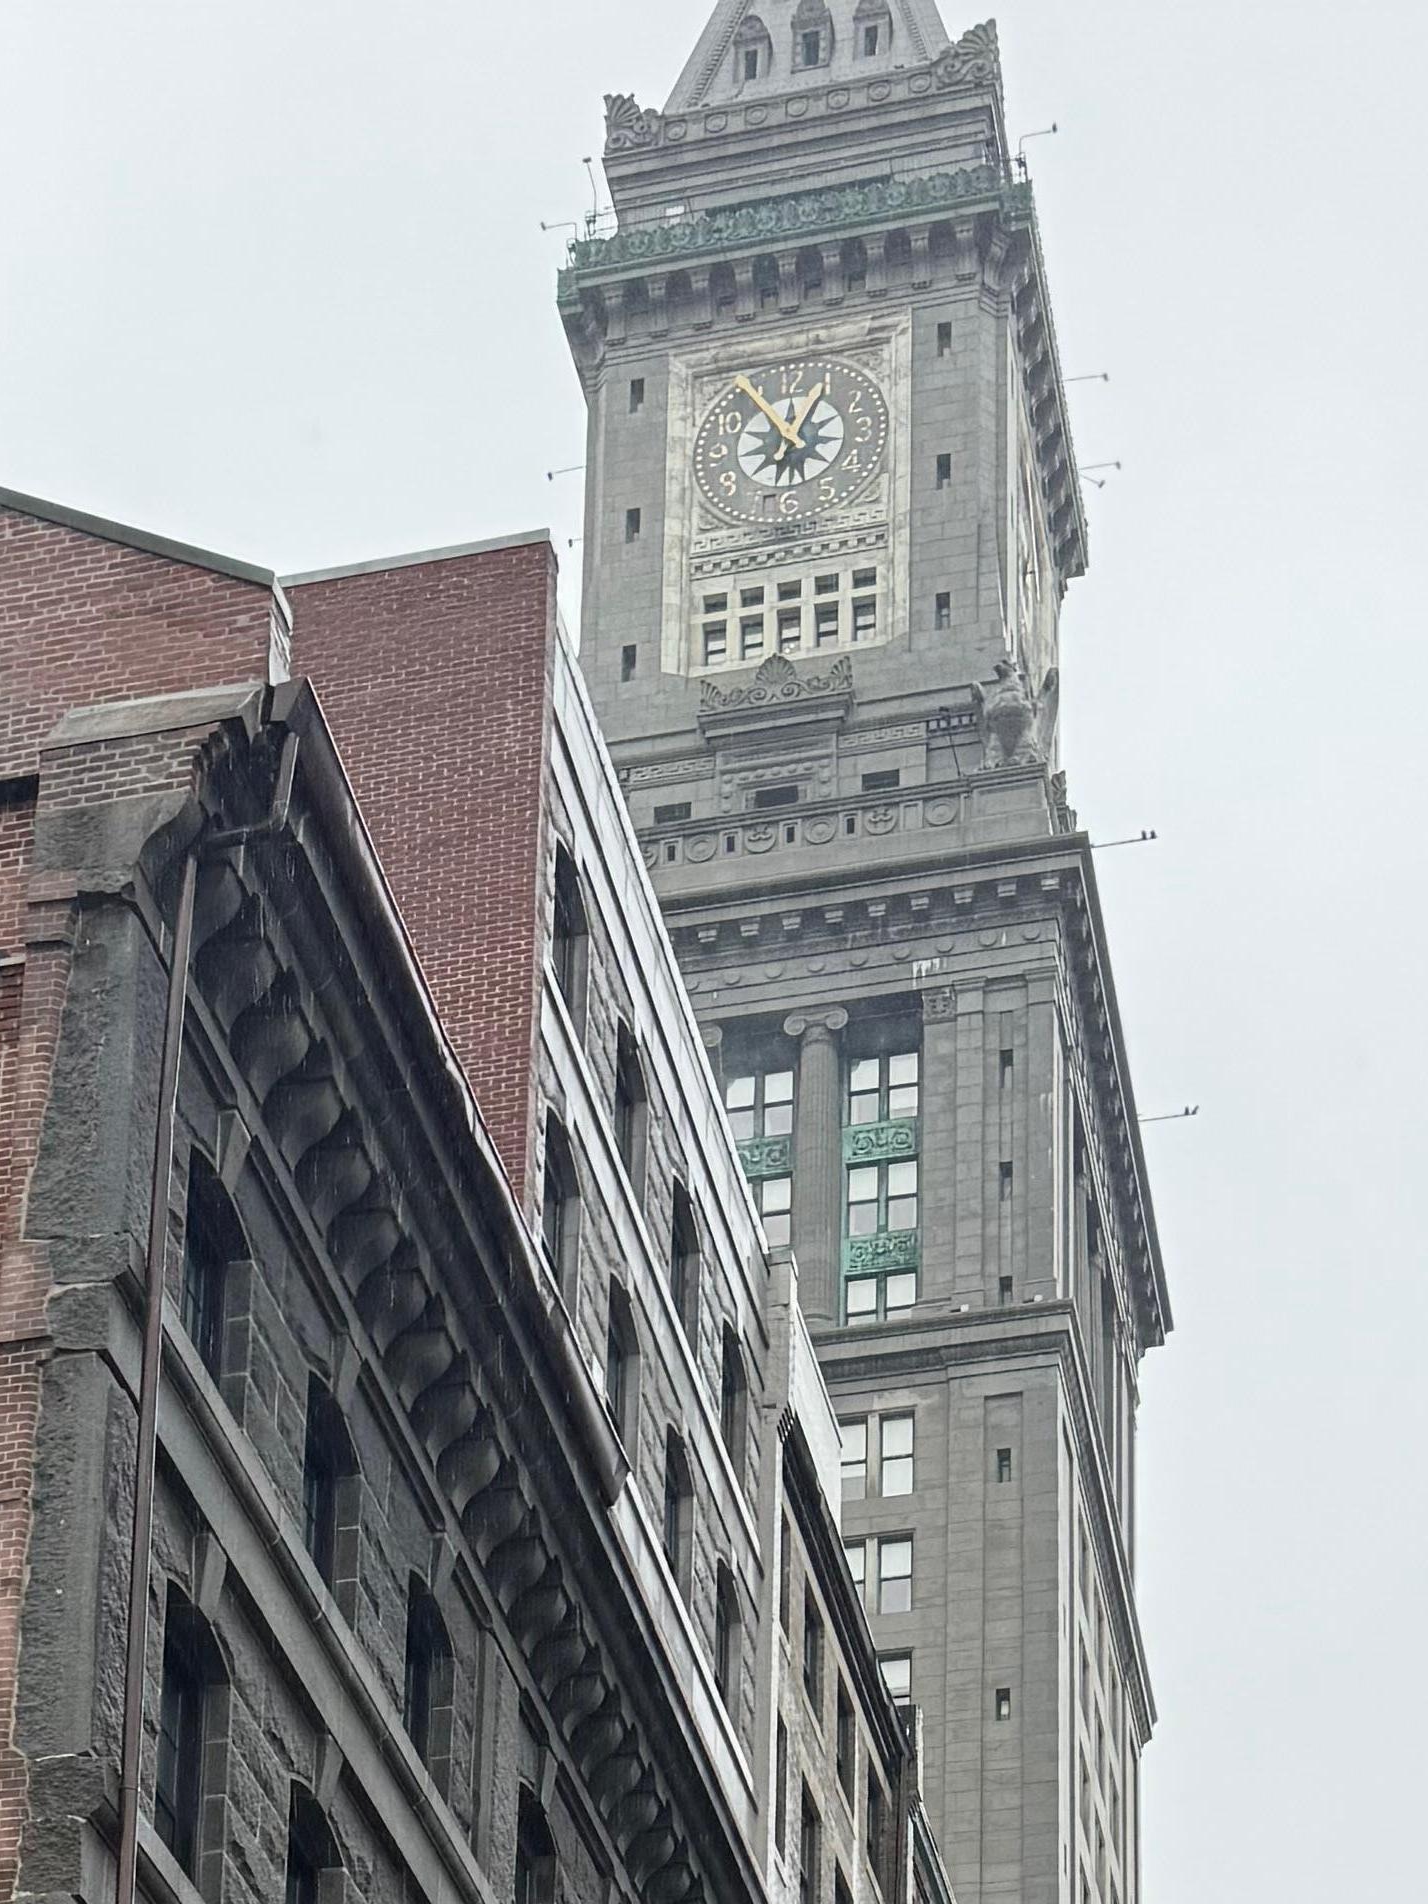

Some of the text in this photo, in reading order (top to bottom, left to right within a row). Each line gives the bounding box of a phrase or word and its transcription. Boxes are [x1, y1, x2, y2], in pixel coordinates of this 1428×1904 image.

[781, 371, 803, 394] 12
[848, 390, 863, 413] 2
[718, 411, 741, 435] 10
[854, 416, 872, 442] 3
[841, 449, 861, 472] 4
[819, 477, 836, 500] 5
[779, 491, 798, 514] 6
